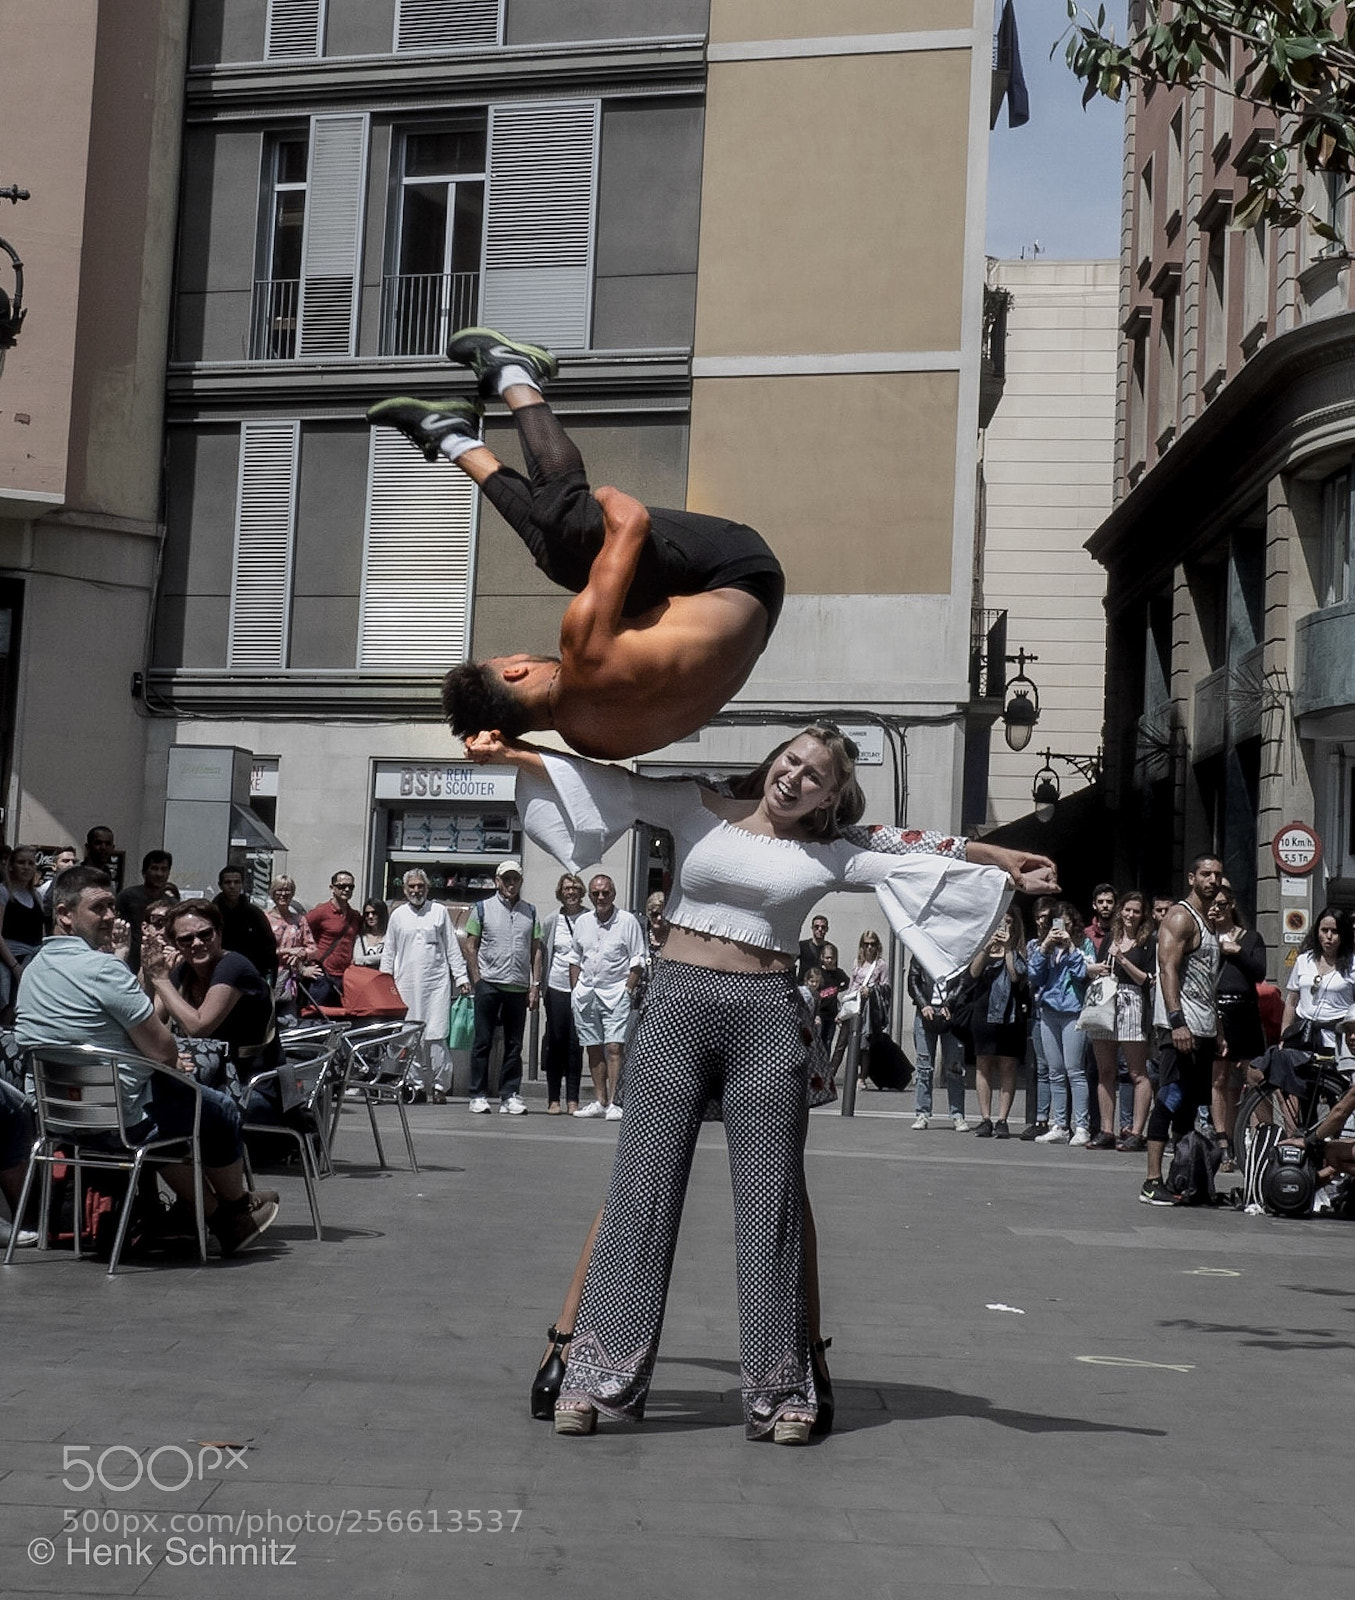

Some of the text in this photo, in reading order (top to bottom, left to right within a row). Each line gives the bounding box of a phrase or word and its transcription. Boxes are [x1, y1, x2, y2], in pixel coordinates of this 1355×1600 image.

[401, 767, 442, 797] BSC
[446, 769, 474, 782] RENT
[445, 782, 495, 796] SCOOTER
[1281, 838, 1290, 847] 10
[1297, 853, 1309, 863] Tn
